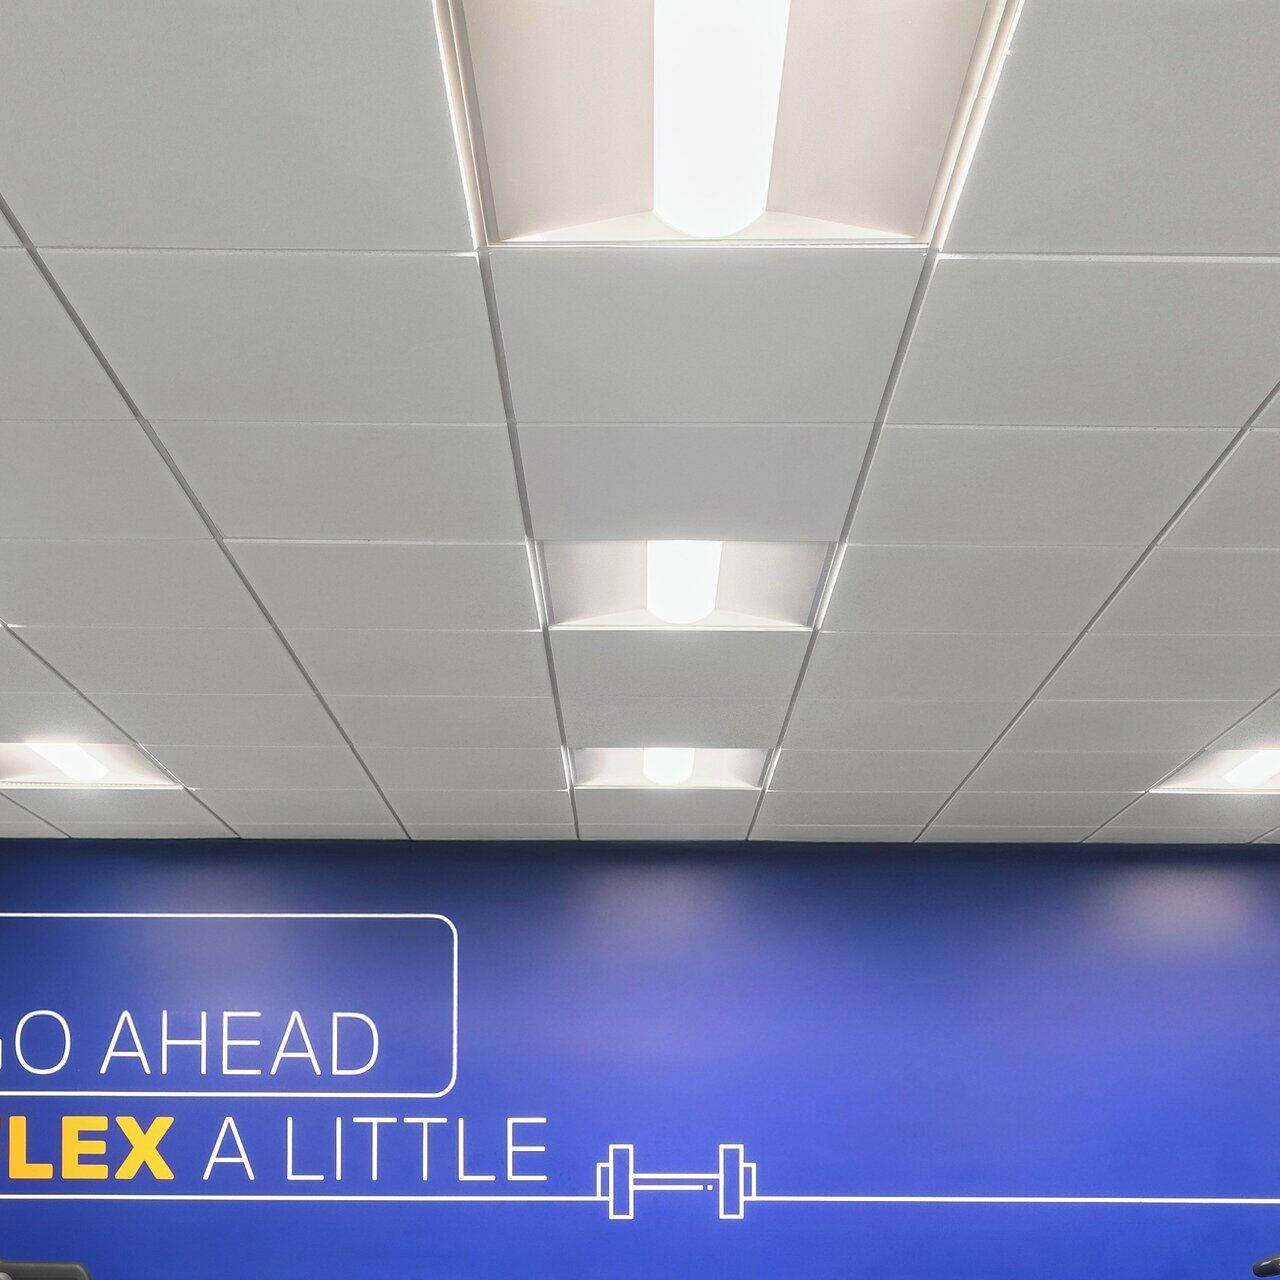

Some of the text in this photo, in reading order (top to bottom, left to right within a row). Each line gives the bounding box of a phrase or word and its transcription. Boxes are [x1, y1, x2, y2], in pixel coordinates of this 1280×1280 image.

[100, 1010, 380, 1075] AHEAD
[203, 1116, 255, 1181] A
[286, 1117, 548, 1182] LITTLE
